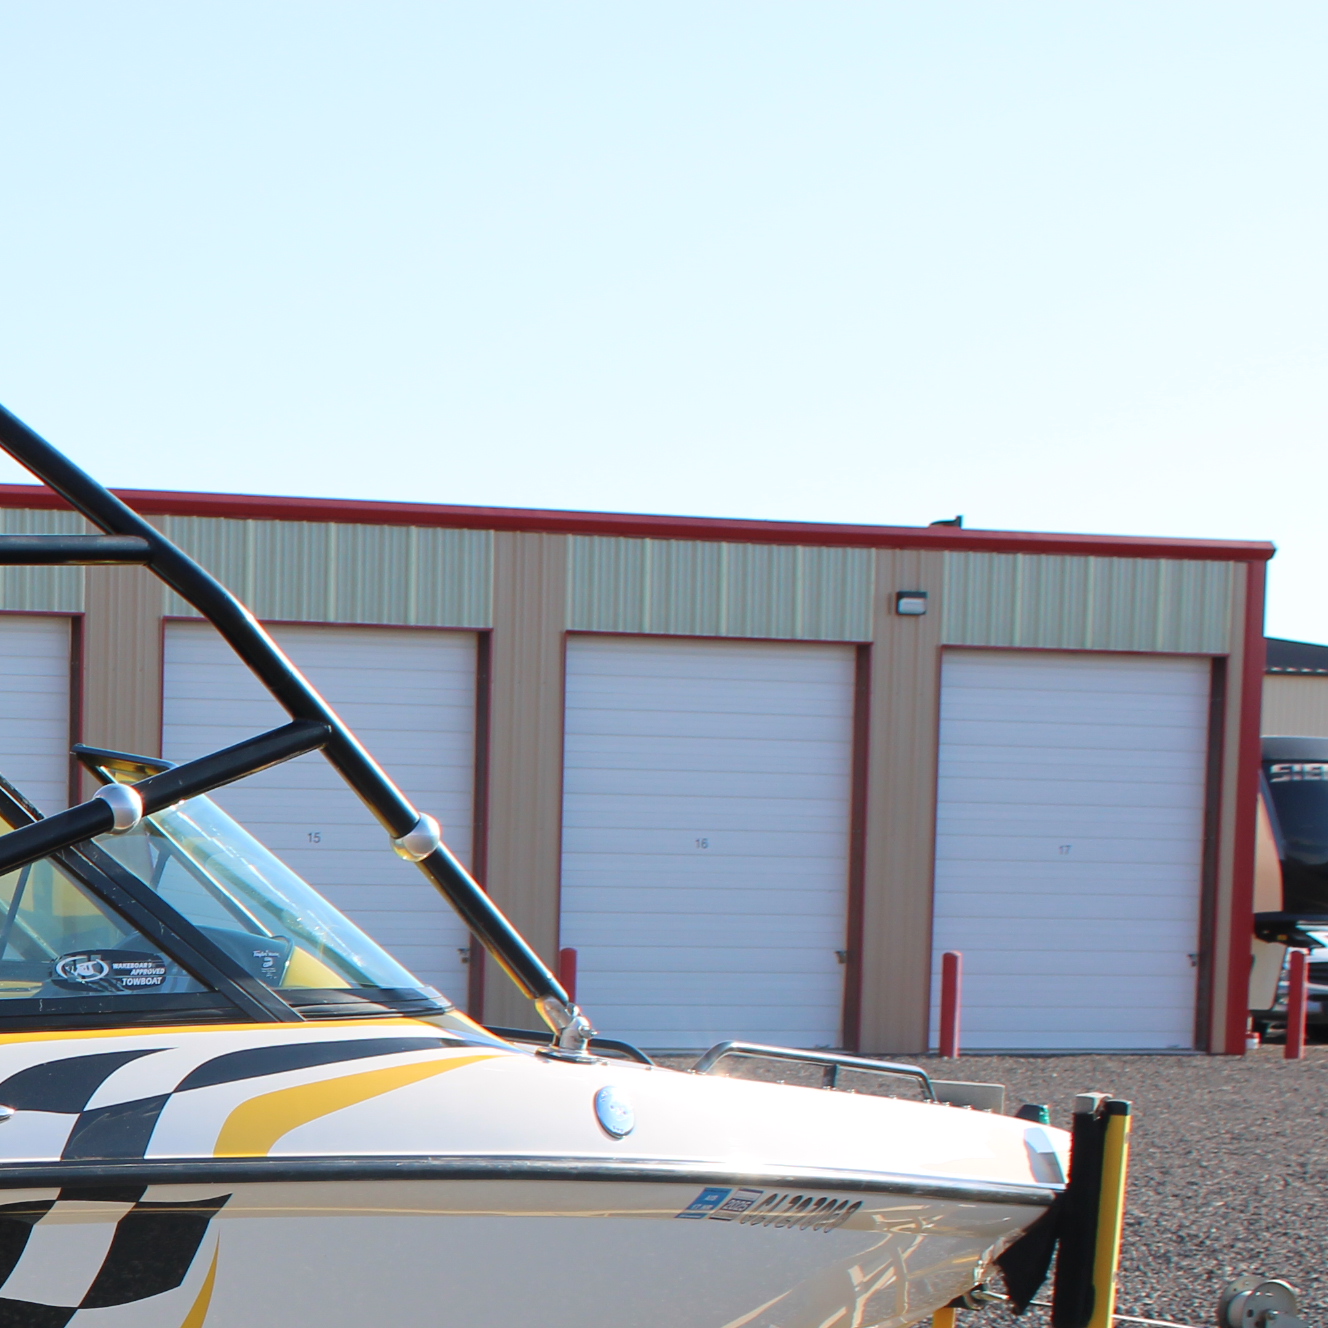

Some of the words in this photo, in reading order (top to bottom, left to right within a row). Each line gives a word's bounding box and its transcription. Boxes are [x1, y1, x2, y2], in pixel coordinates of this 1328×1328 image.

[308, 832, 322, 844] 15
[695, 838, 709, 849] 16
[1058, 844, 1073, 856] 17
[130, 968, 165, 976] APPROVED
[122, 976, 163, 986] TOWBOAT
